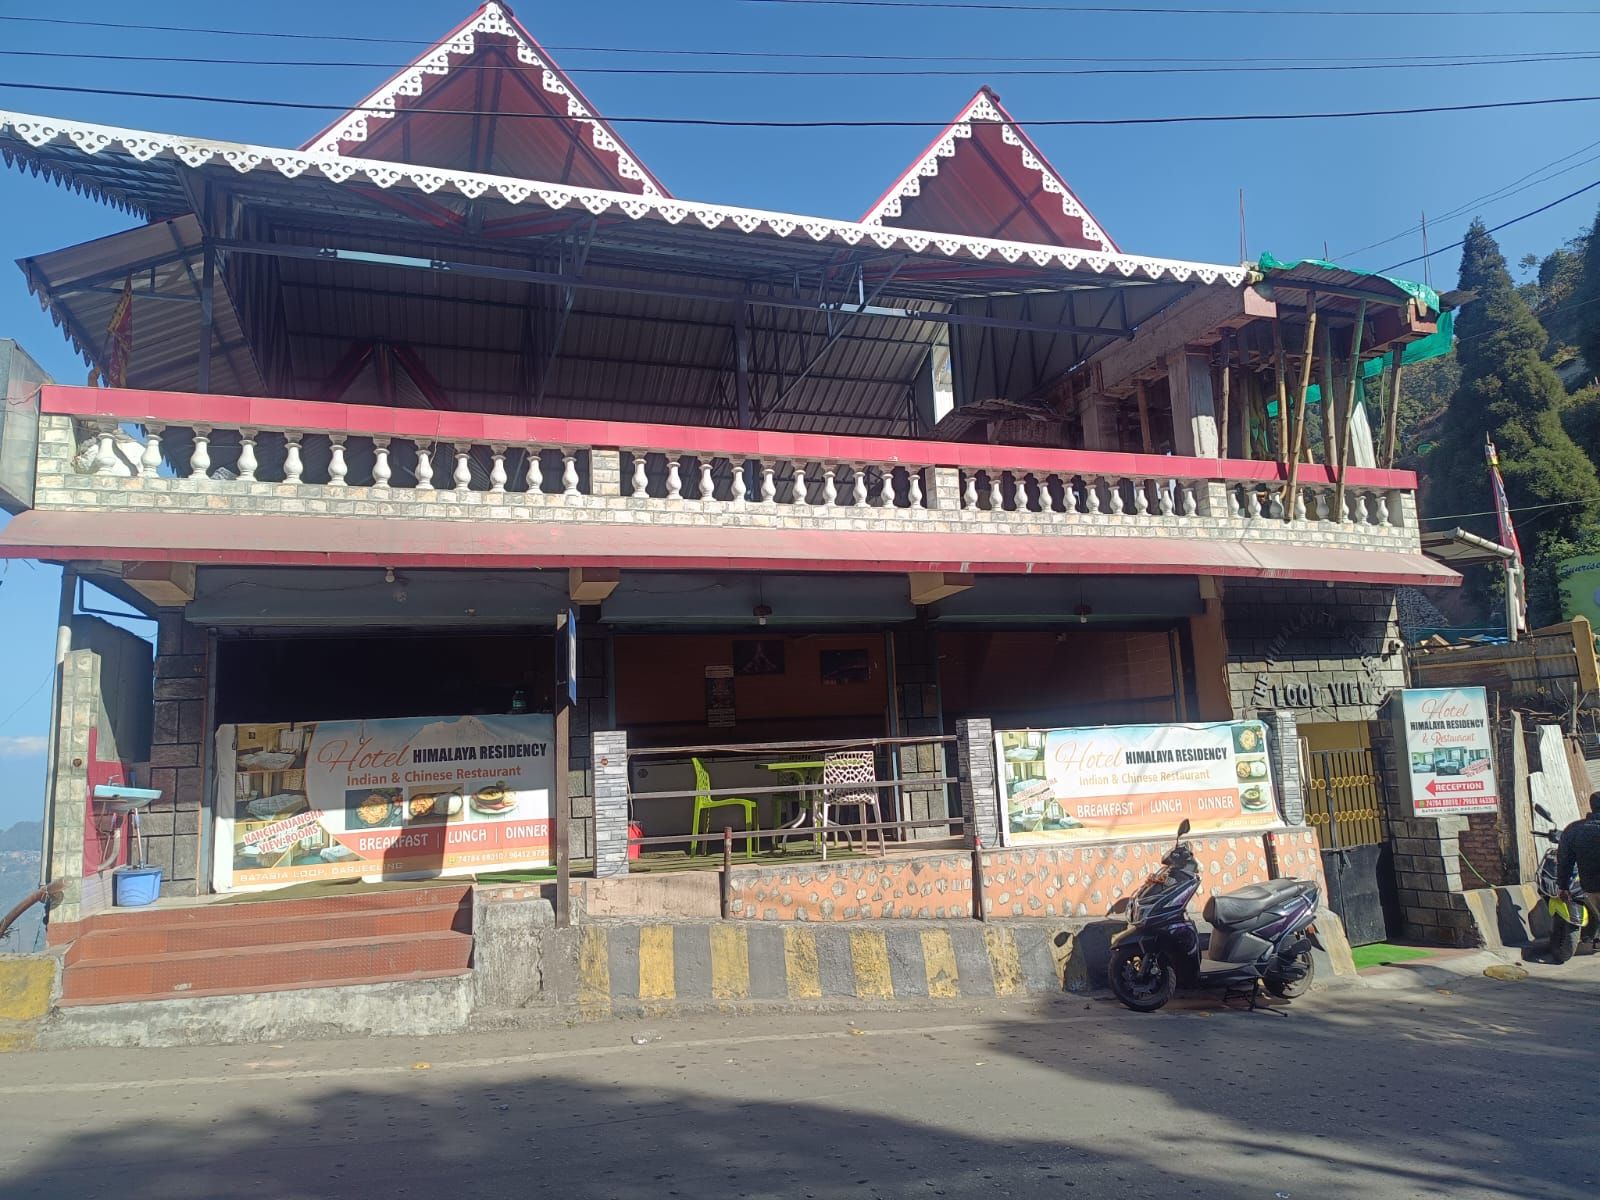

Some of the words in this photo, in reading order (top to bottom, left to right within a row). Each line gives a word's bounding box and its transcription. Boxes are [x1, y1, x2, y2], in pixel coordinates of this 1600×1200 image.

[1252, 672, 1268, 706] THE
[1272, 683, 1322, 707] LOOP
[1328, 681, 1376, 706] VIEW
[1421, 699, 1469, 719] Hotel
[1410, 721, 1446, 731] HIMALAYA
[1446, 719, 1484, 729] RESIDENCY
[1431, 731, 1475, 746] Restaurant
[317, 736, 410, 773] Hotel
[413, 747, 477, 763] HIMALAYA
[480, 743, 547, 759] RESIDENCY
[1055, 740, 1124, 772] Hotel
[1125, 750, 1173, 765] HIMALAYA
[1175, 747, 1227, 761] RESIDENCY
[347, 773, 387, 786] Indian
[391, 772, 401, 784] &
[404, 770, 453, 783] Chinese
[456, 766, 522, 780] Restaurant
[1079, 774, 1109, 786] Indian
[1111, 773, 1119, 785] &
[1121, 772, 1158, 784] Chinese
[1160, 769, 1211, 781] Restaurant
[1435, 783, 1482, 792] RECEPTION
[1077, 802, 1134, 818] BREAKFAST
[1150, 799, 1183, 814] LUNCH
[1198, 795, 1234, 810] DINNER
[244, 809, 325, 844] KANCHANJANGHA
[359, 833, 429, 851] BREAKFAST
[448, 829, 487, 844] LUNCH
[505, 825, 548, 839] DINNER
